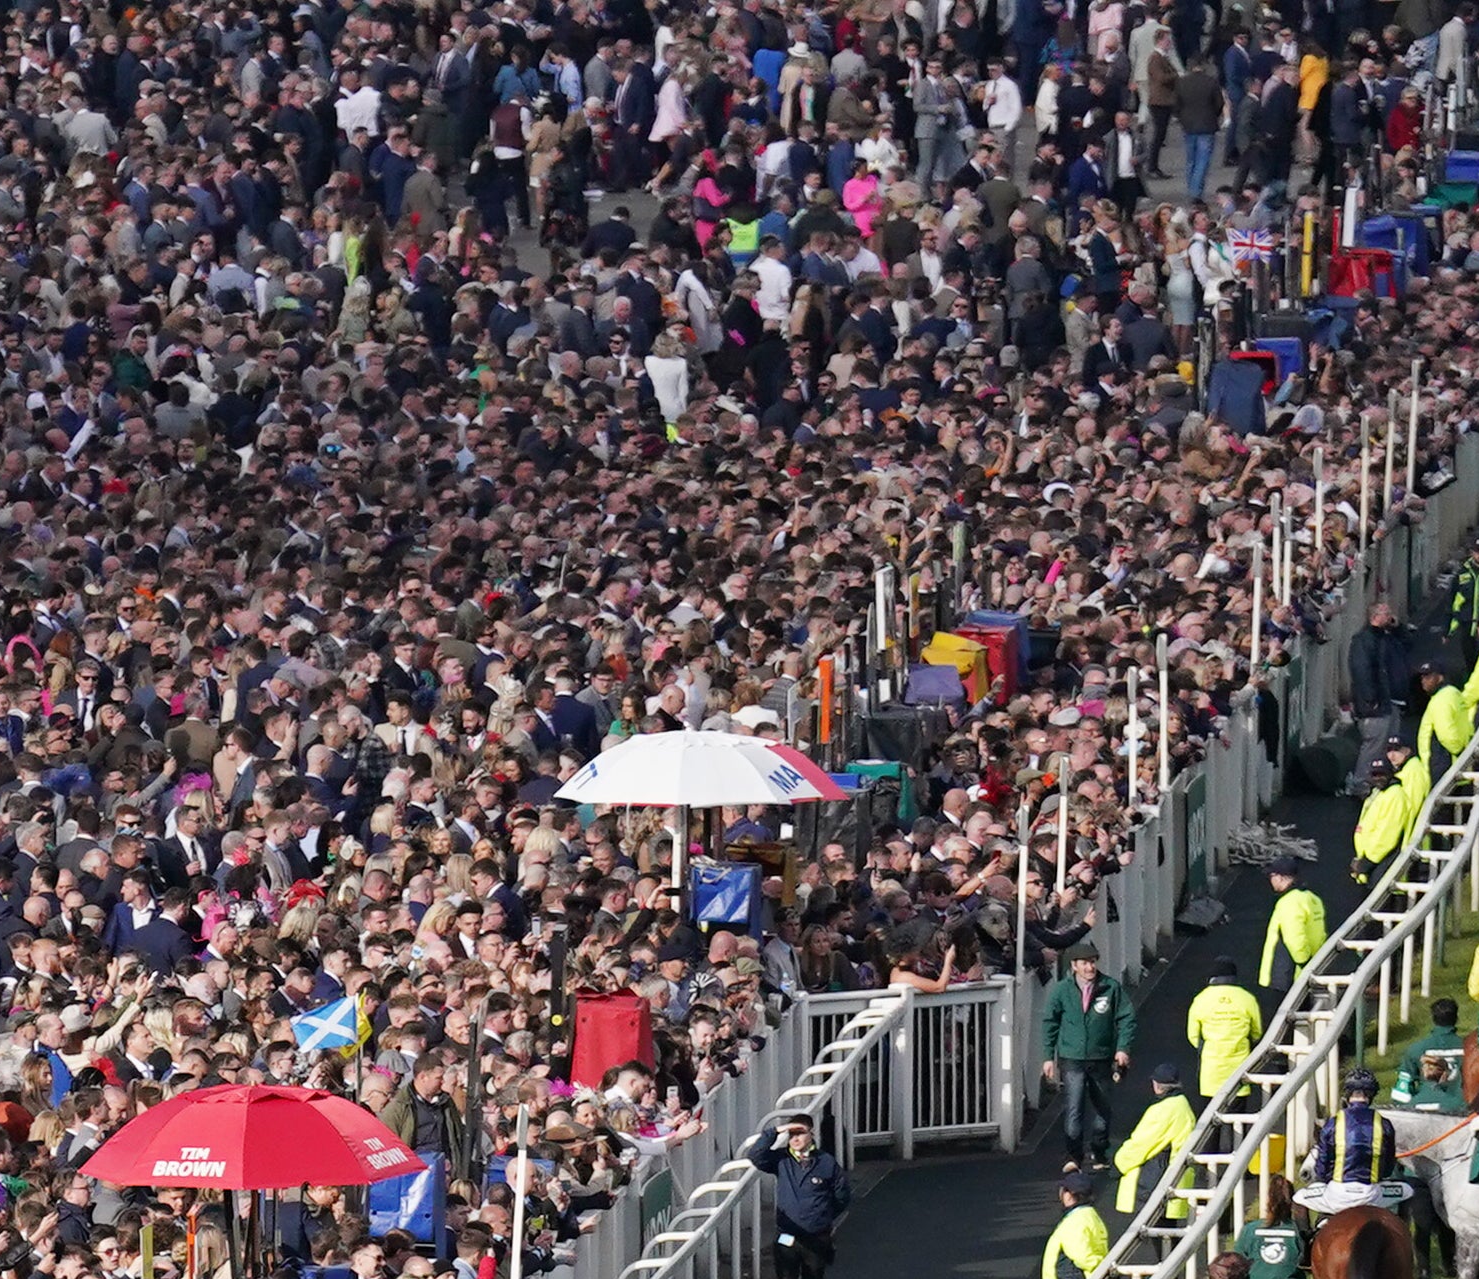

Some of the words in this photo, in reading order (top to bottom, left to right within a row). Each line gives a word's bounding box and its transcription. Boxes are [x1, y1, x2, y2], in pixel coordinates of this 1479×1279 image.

[362, 1136, 384, 1150] TIM
[180, 1147, 210, 1160] TIM
[366, 1148, 408, 1170] BROWN
[151, 1160, 226, 1178] BROWN
